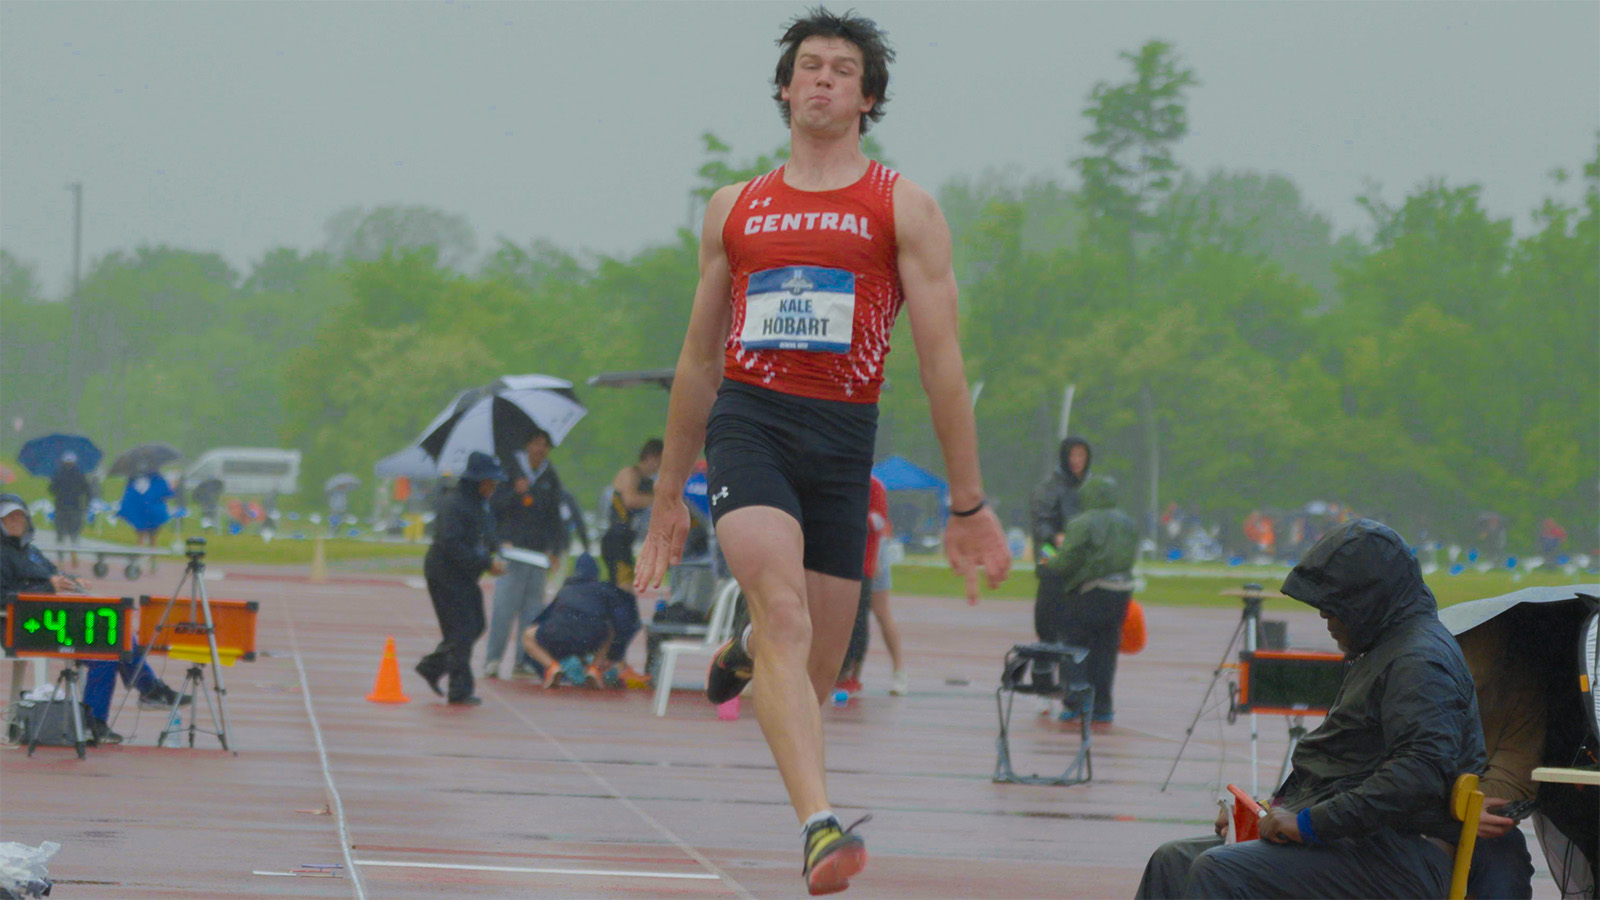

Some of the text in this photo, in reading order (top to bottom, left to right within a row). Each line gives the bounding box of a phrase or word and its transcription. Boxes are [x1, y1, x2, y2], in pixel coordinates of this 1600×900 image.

[744, 212, 873, 240] CENTRAL
[779, 299, 813, 313] KALE
[762, 317, 830, 336] HOBART
[23, 607, 118, 646] +4.17
